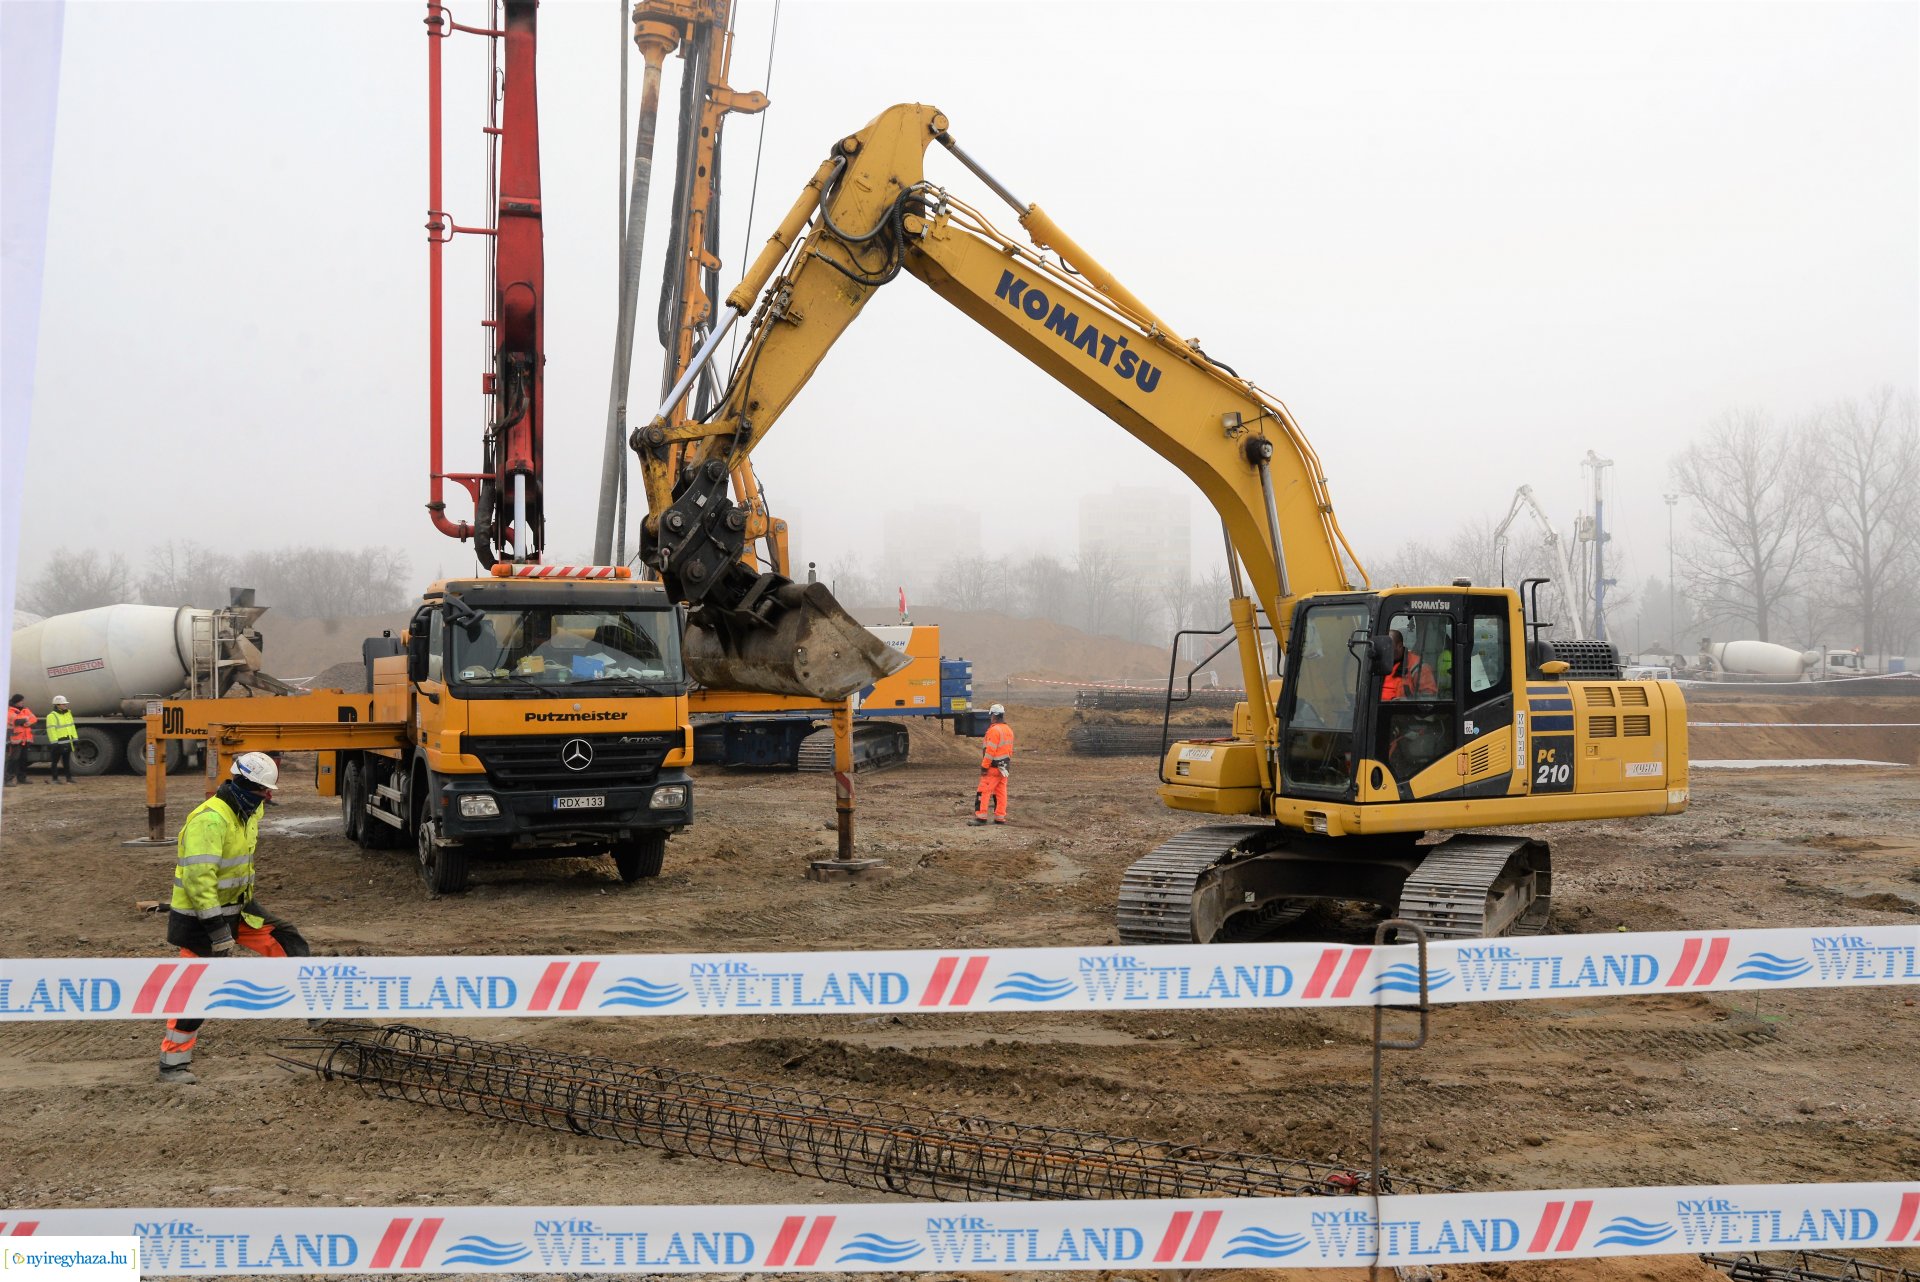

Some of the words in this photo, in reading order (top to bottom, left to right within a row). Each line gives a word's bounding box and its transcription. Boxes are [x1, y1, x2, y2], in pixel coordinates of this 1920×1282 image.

[994, 268, 1162, 393] KOMATSU
[1411, 599, 1450, 610] KOMATSU
[525, 711, 628, 722] Putzmeister
[1537, 748, 1556, 763] PC
[1536, 764, 1570, 784] 210
[559, 797, 604, 808] RDX-133
[689, 972, 909, 1007] WETLAND
[1078, 965, 1294, 1002] WETLAND
[1457, 954, 1659, 993] WETLAND
[297, 976, 517, 1011] WETLAND
[1311, 1218, 1520, 1257] WETLAND
[1677, 1208, 1879, 1245] WETLAND
[139, 1234, 359, 1269] WETLAND
[533, 1231, 755, 1266] WETLAND
[926, 1227, 1144, 1263] WETLAND
